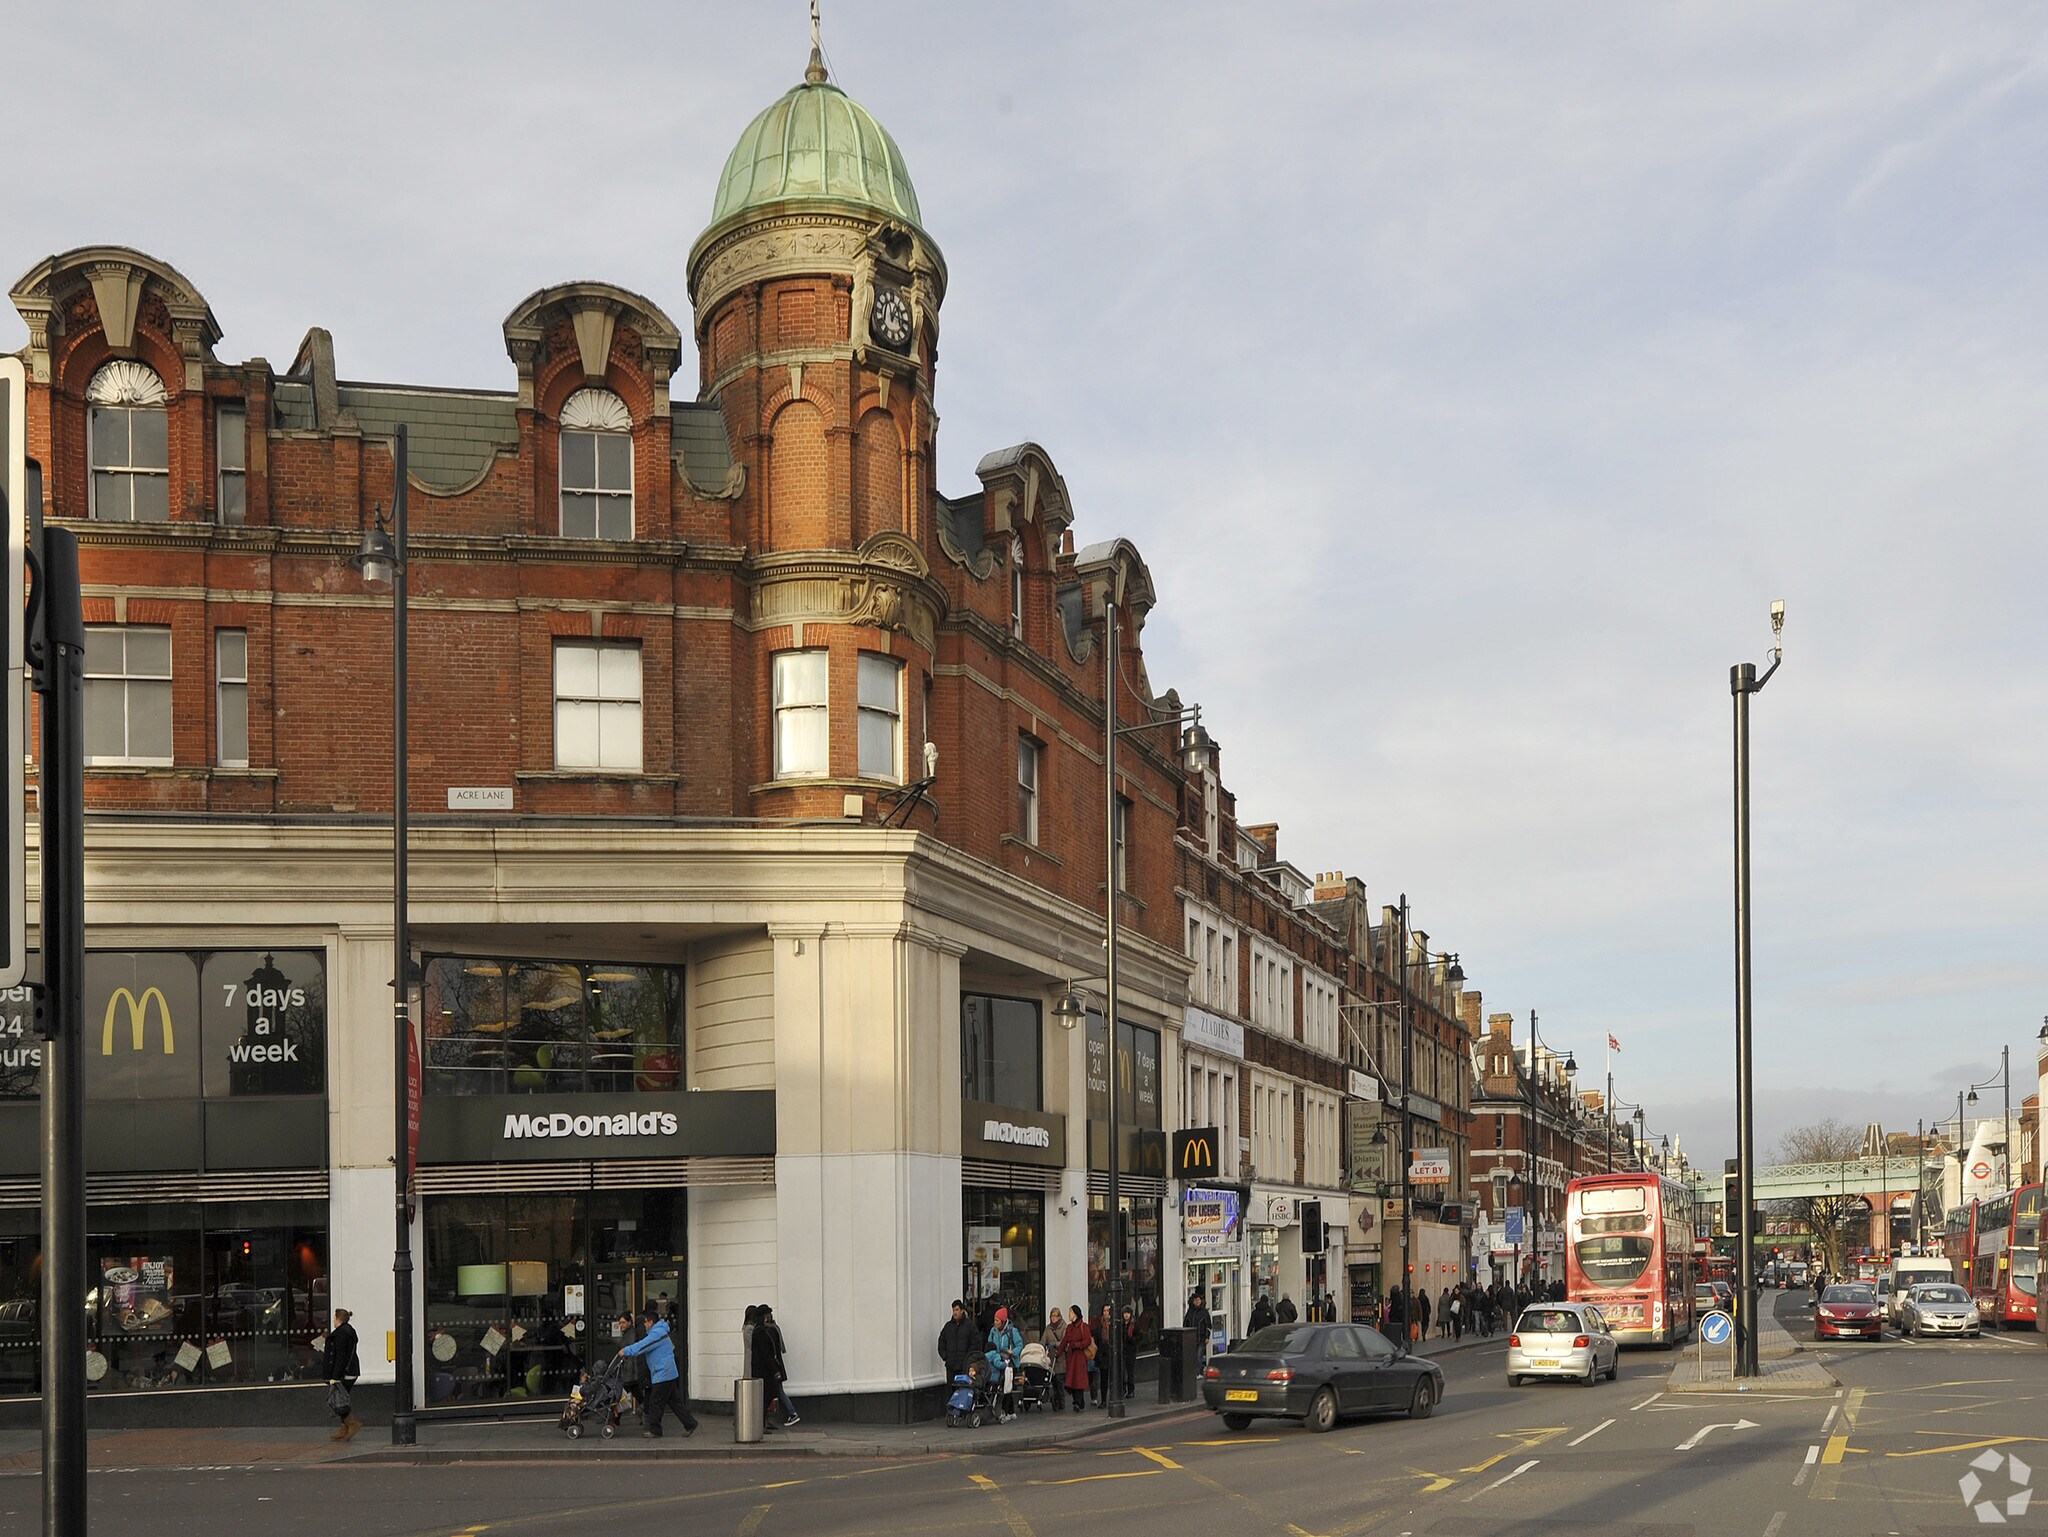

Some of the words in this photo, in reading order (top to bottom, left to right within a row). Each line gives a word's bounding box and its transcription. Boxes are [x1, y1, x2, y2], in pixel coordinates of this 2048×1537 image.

[456, 791, 479, 800] ACRE
[482, 791, 505, 800] LANE
[223, 984, 238, 1007] 7
[246, 983, 305, 1012] days
[255, 1017, 270, 1035] a
[1200, 1016, 1230, 1041] ZIADIES
[229, 1038, 299, 1063] week
[1088, 1040, 1105, 1056] open
[1092, 1058, 1101, 1075] 24
[1142, 1053, 1155, 1072] days
[1087, 1072, 1107, 1093] hours
[1144, 1075, 1149, 1087] a
[1138, 1089, 1155, 1105] week
[504, 1111, 678, 1139] McDonald's
[984, 1120, 1050, 1148] McDonald's
[1353, 1154, 1380, 1163] Shiatsu
[1415, 1166, 1430, 1175] LET
[1432, 1166, 1444, 1174] BY
[1188, 1205, 1198, 1217] OFF
[1199, 1204, 1221, 1217] LICENCE
[1271, 1212, 1292, 1221] HSBC
[1191, 1234, 1219, 1245] oyster
